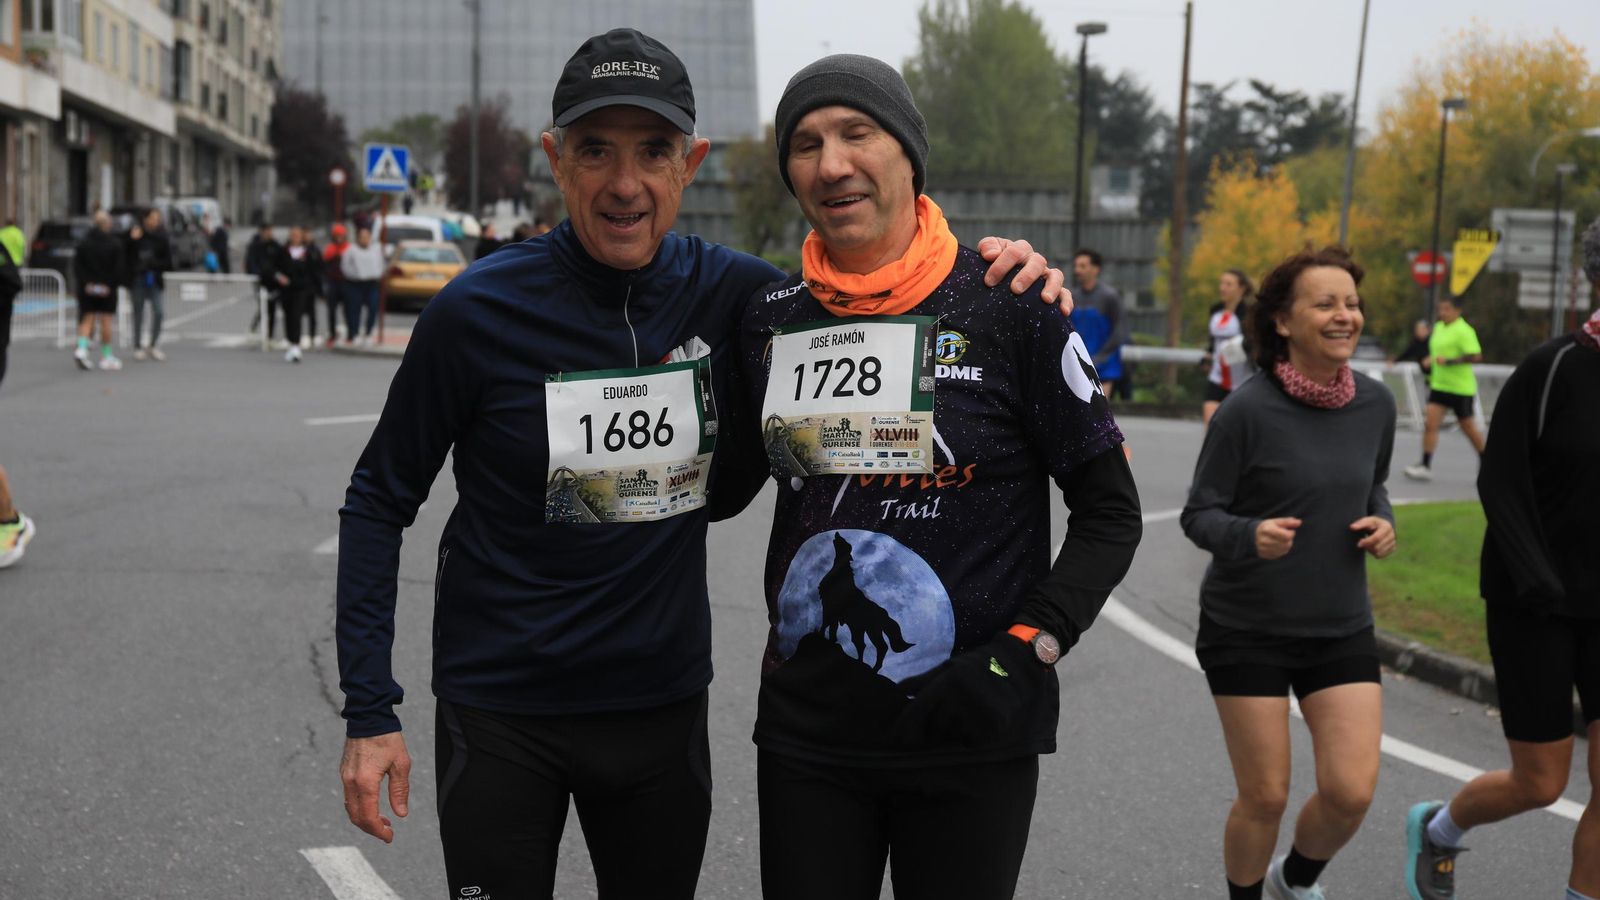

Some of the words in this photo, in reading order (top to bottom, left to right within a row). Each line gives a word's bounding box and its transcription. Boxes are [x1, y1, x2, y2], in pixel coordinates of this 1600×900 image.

[592, 61, 658, 75] GORE-TEX
[808, 333, 831, 350] JOSÉ
[831, 329, 865, 347] RAMÓN
[794, 356, 882, 401] 1728
[603, 384, 648, 400] EDUARDO
[580, 406, 674, 454] 1686
[873, 428, 918, 441] XLVIII
[619, 477, 638, 485] SAN
[669, 468, 700, 488] XLVIII
[618, 490, 658, 498] OURENSE
[880, 496, 941, 520] Trail
